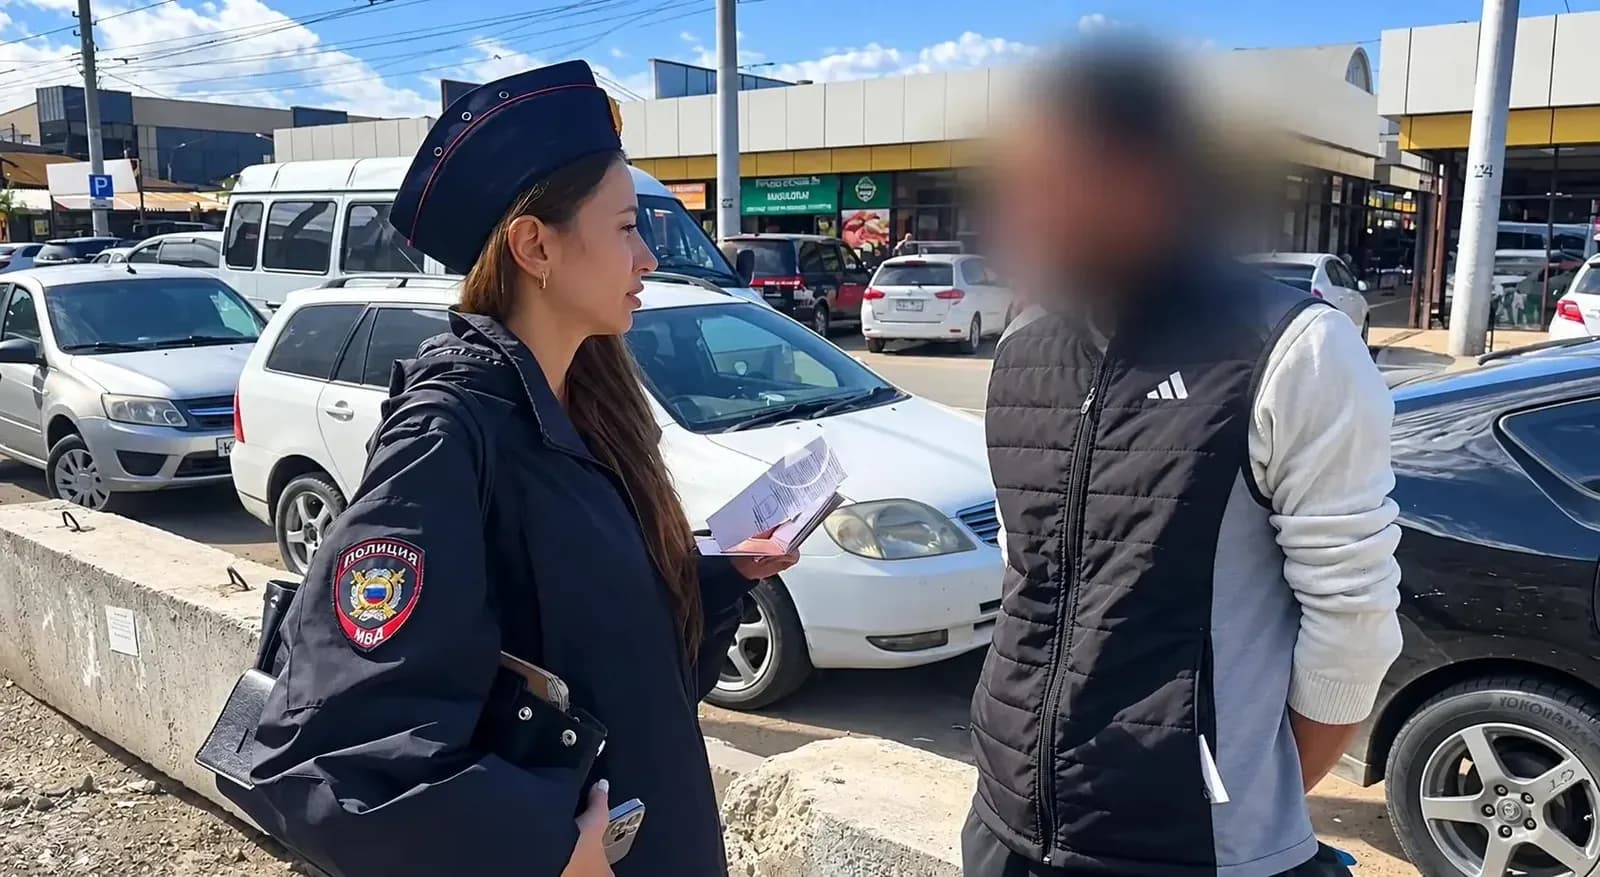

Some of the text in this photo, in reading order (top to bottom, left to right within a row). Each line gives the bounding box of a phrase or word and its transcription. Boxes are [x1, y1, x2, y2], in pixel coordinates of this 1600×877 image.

[95, 177, 107, 195] P
[343, 543, 418, 568] ПОЛИЦИЯ
[353, 626, 385, 645] МВД
